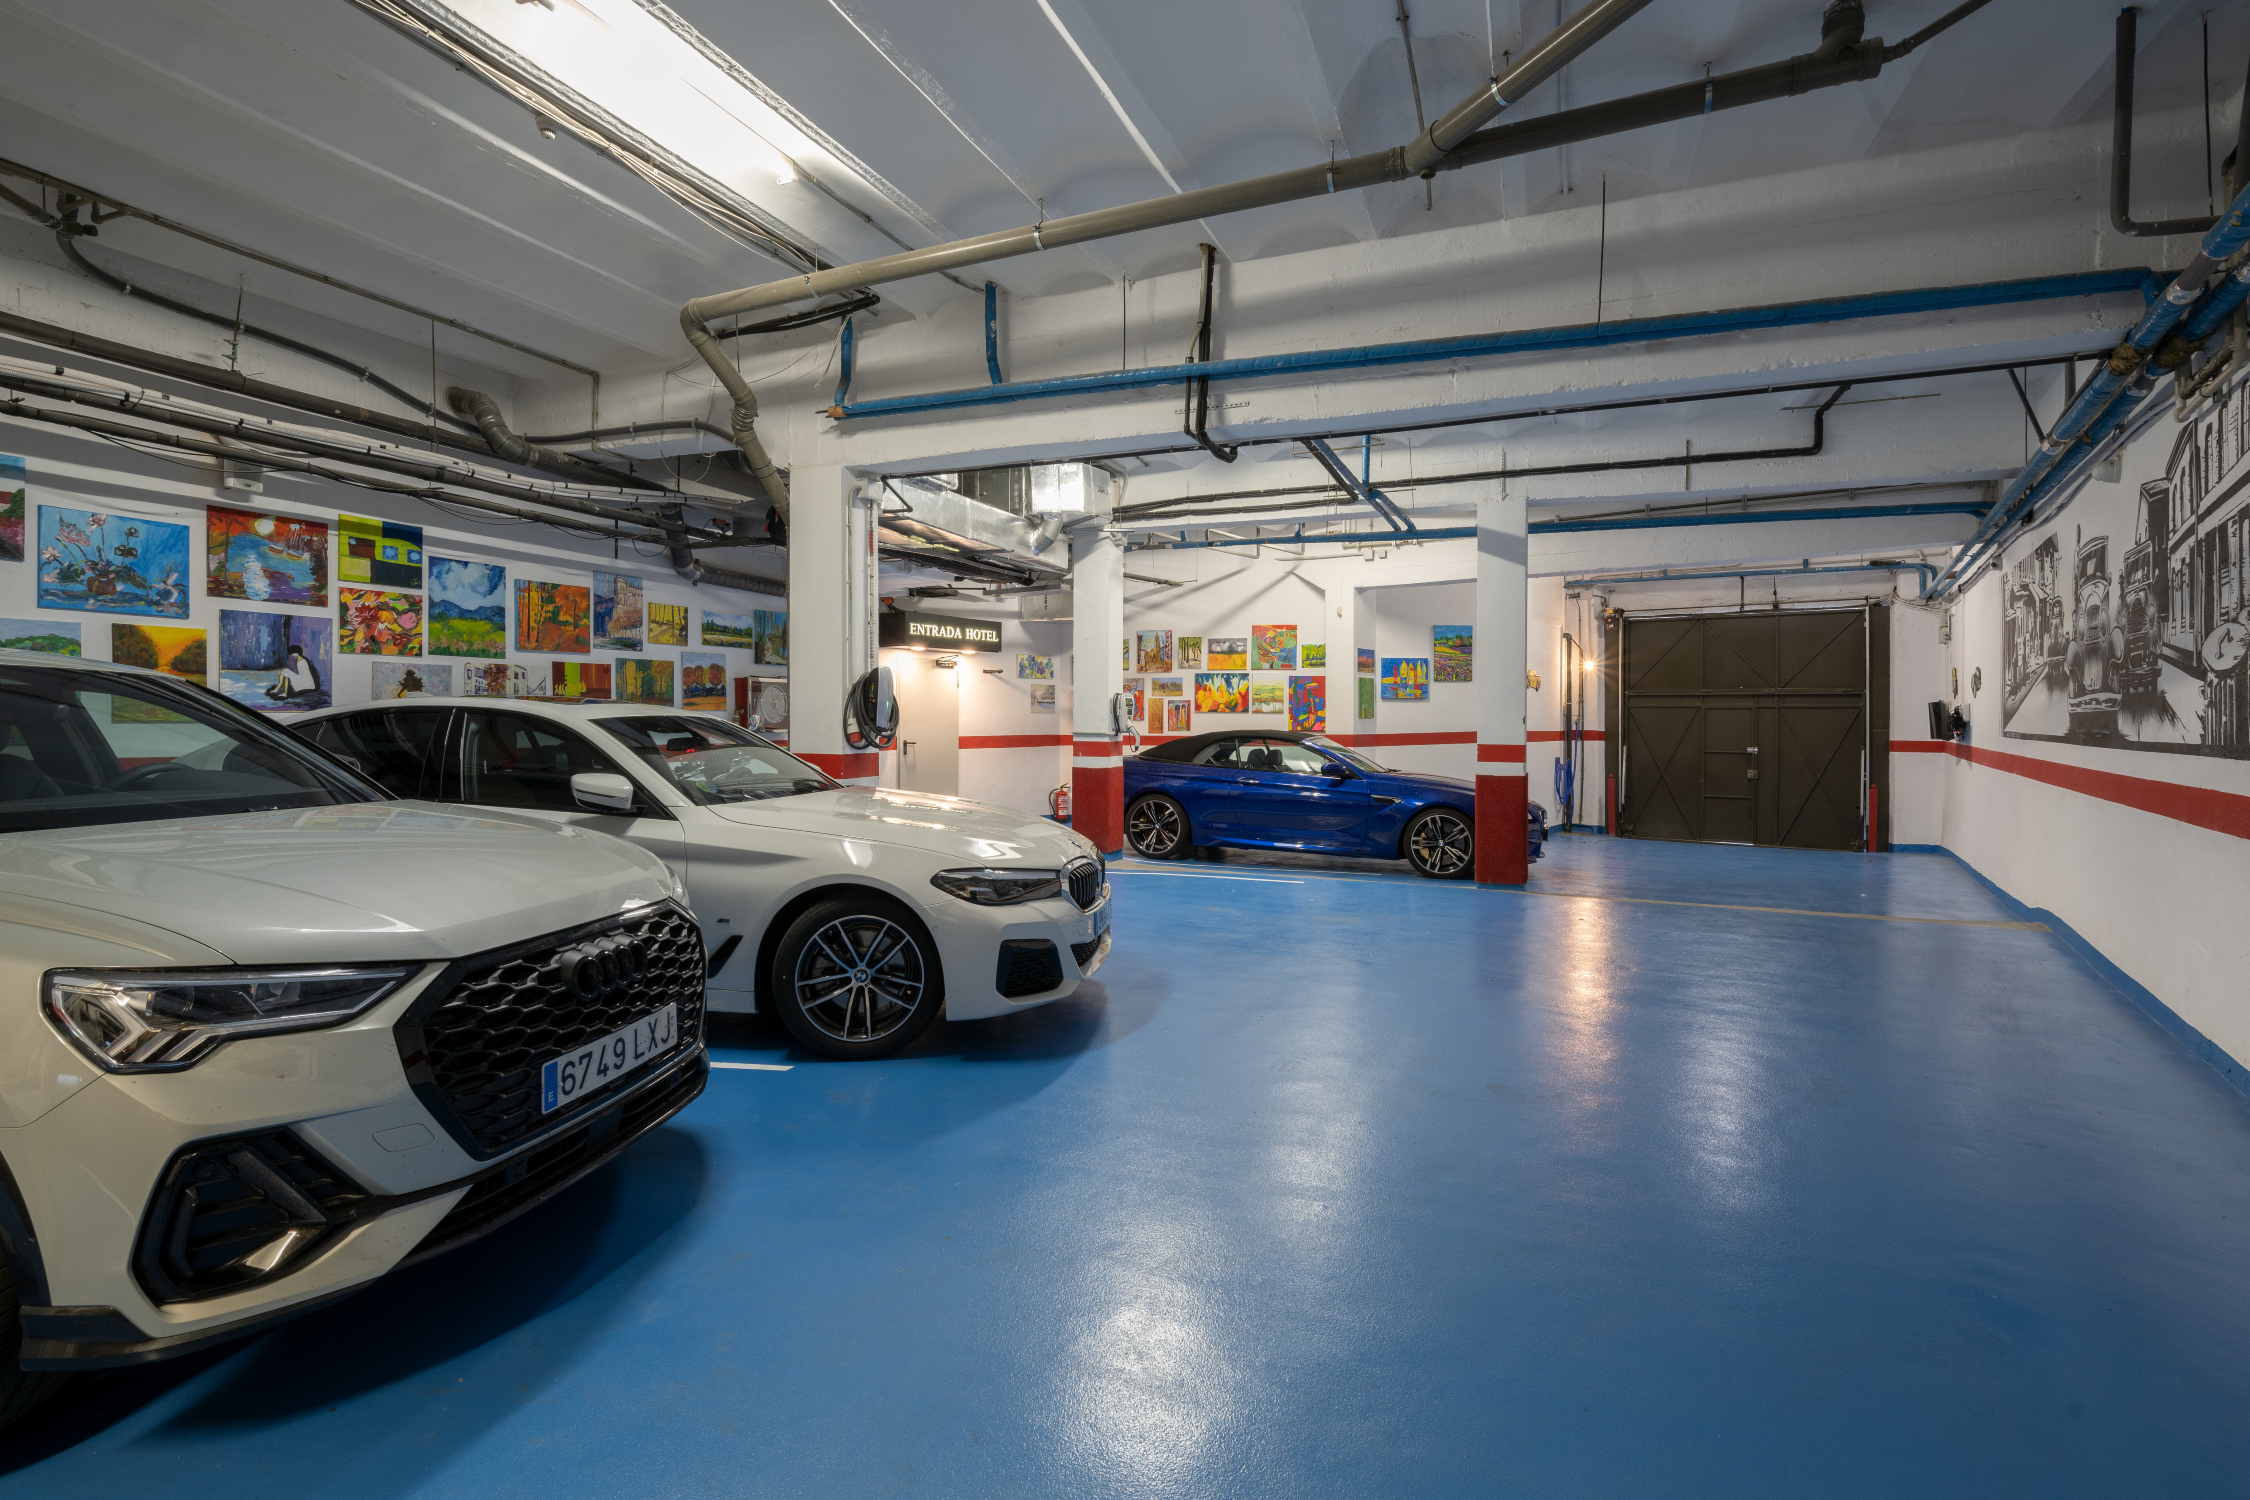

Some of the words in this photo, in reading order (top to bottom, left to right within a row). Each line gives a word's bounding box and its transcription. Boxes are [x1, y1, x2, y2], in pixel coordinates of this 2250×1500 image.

[909, 622, 962, 639] ENTRADA
[965, 628, 999, 642] HOTEL
[561, 1037, 626, 1096] 6749
[633, 1011, 671, 1061] LXJ
[548, 1091, 554, 1103] E
